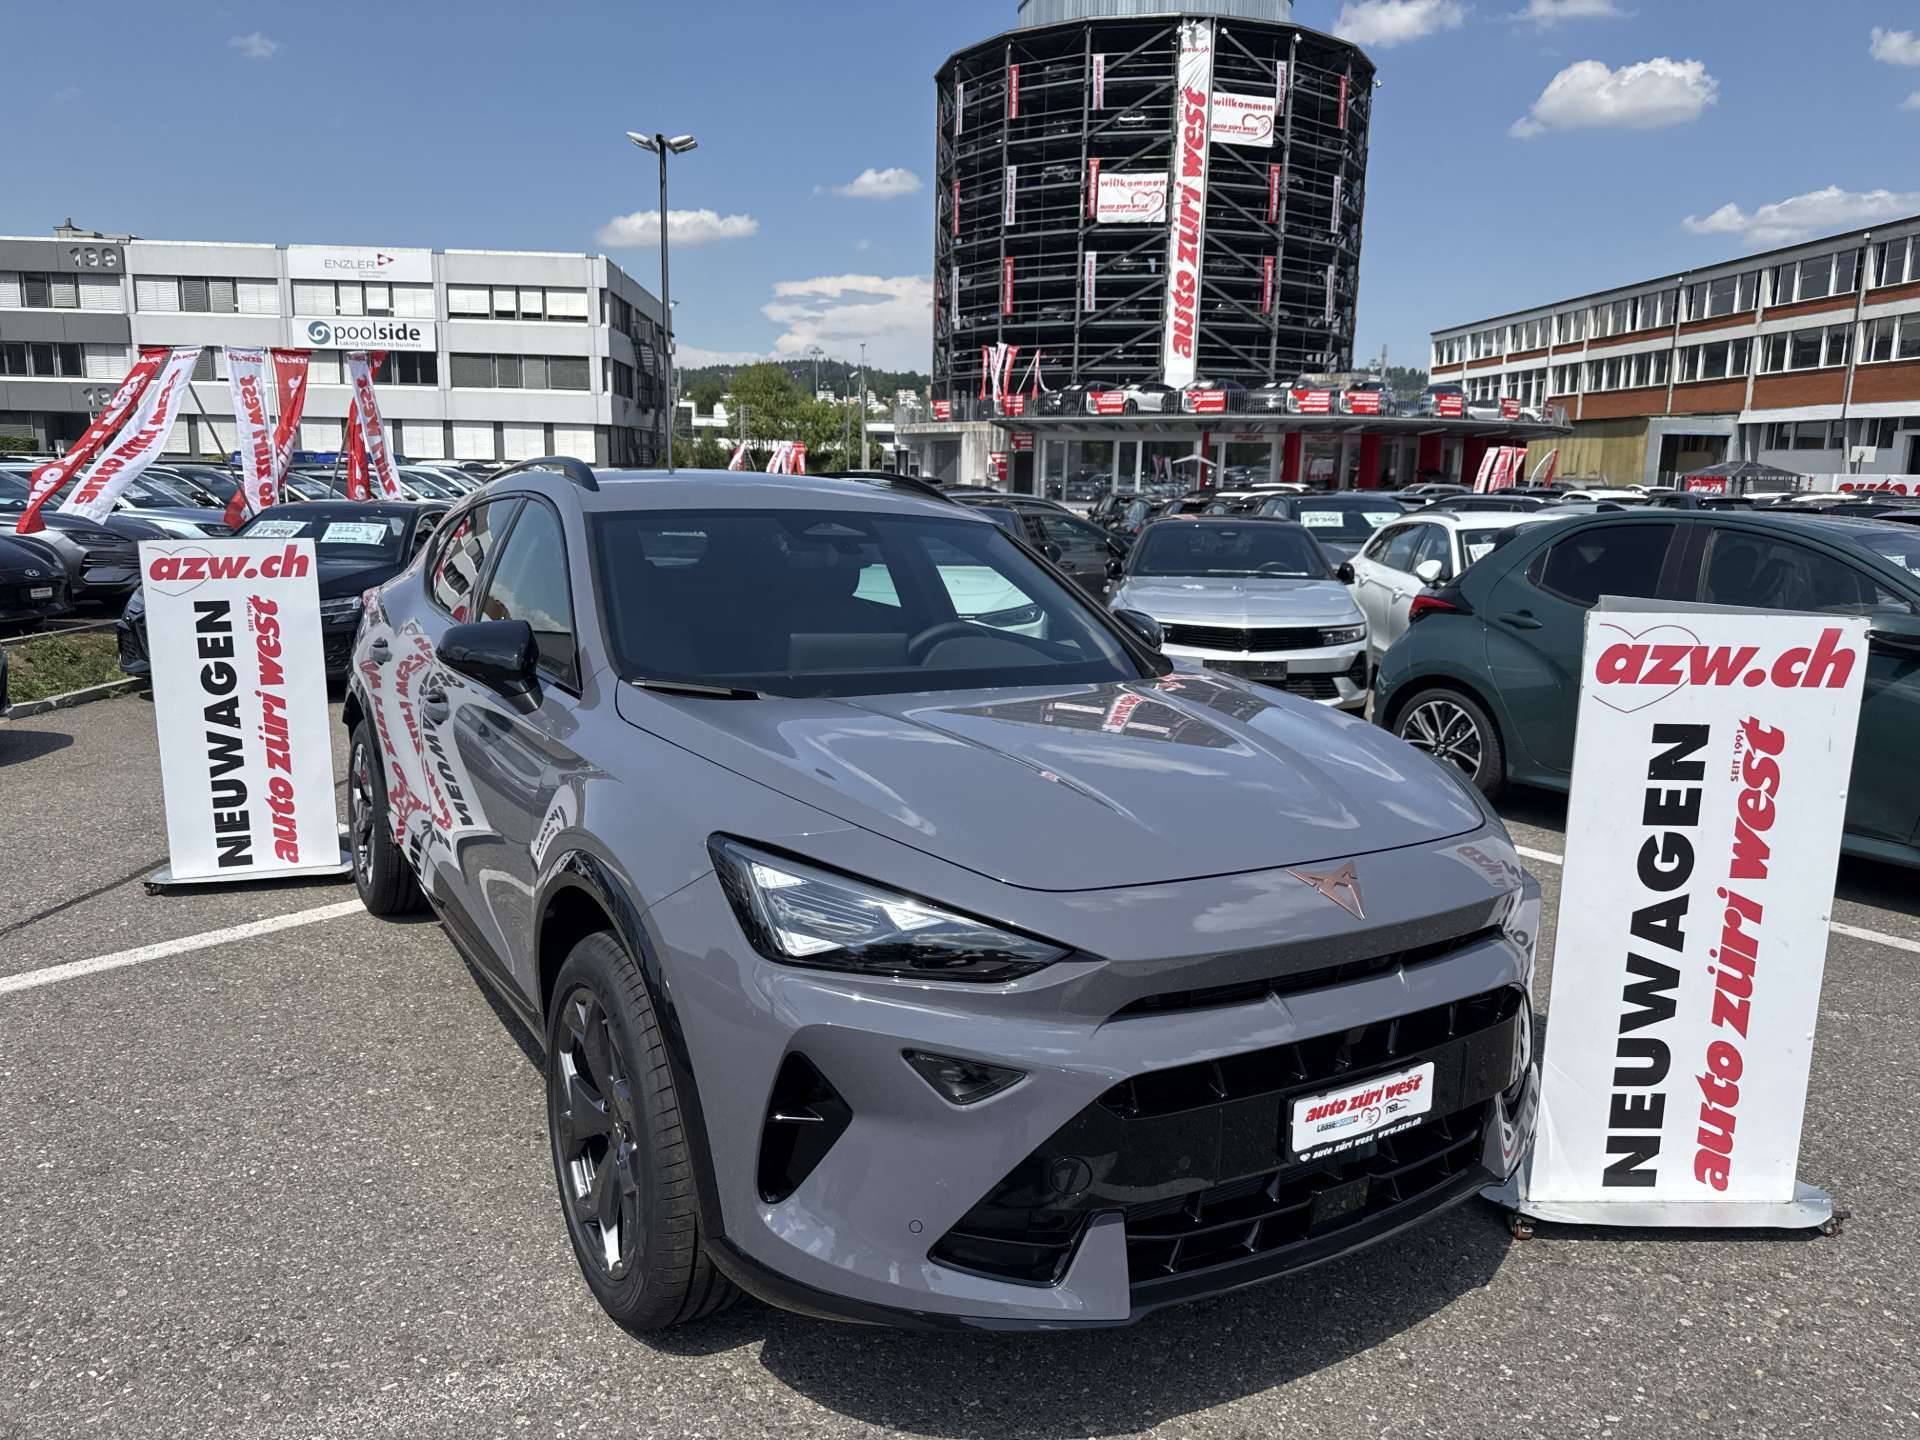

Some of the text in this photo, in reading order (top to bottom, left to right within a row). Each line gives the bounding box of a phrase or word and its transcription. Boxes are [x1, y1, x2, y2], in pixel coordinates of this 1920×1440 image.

[1213, 97, 1273, 111] willkommen
[1101, 178, 1165, 187] willkommen
[1172, 85, 1207, 359] auto züri west
[324, 259, 376, 269] ENZLER
[334, 321, 421, 346] poolside
[148, 544, 309, 582] azw.ch
[1595, 628, 1856, 690] azw.ch
[193, 600, 254, 868] NEUWAGEN
[246, 594, 299, 864] auto züri west
[1730, 729, 1745, 783] SEIT 1991
[1602, 722, 1710, 1188] NEUWAGEN
[1694, 715, 1786, 1192] auto züri west
[1305, 1098, 1349, 1123] auto
[1348, 1084, 1385, 1112] züri
[1386, 1073, 1424, 1100] west
[1312, 1116, 1423, 1160] auto züri west www.azw.ch
